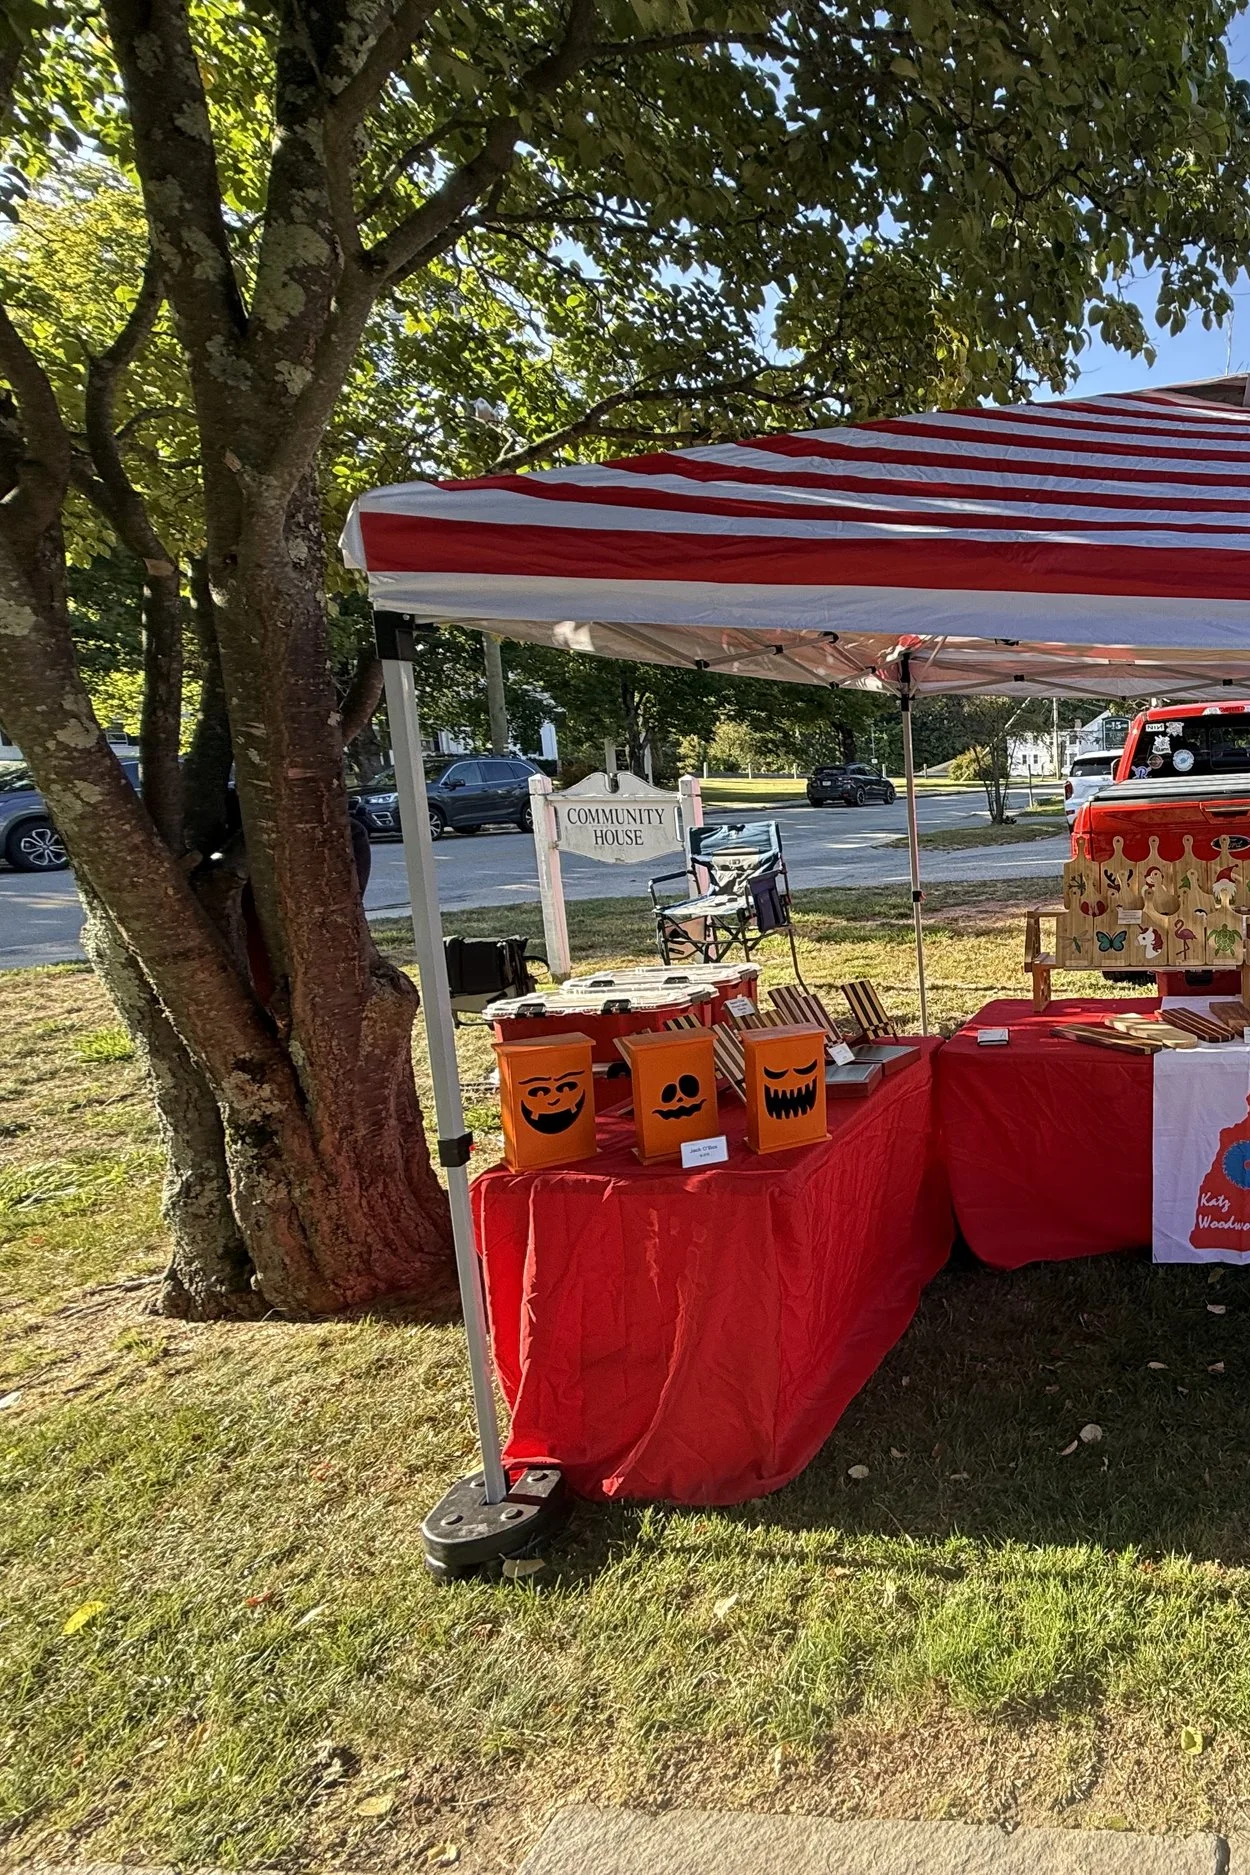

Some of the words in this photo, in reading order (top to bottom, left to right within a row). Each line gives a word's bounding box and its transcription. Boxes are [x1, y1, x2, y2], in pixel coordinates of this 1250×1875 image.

[567, 808, 665, 826] COMMUNITY
[594, 829, 643, 846] HOUSE
[1200, 1192, 1231, 1212] Katz
